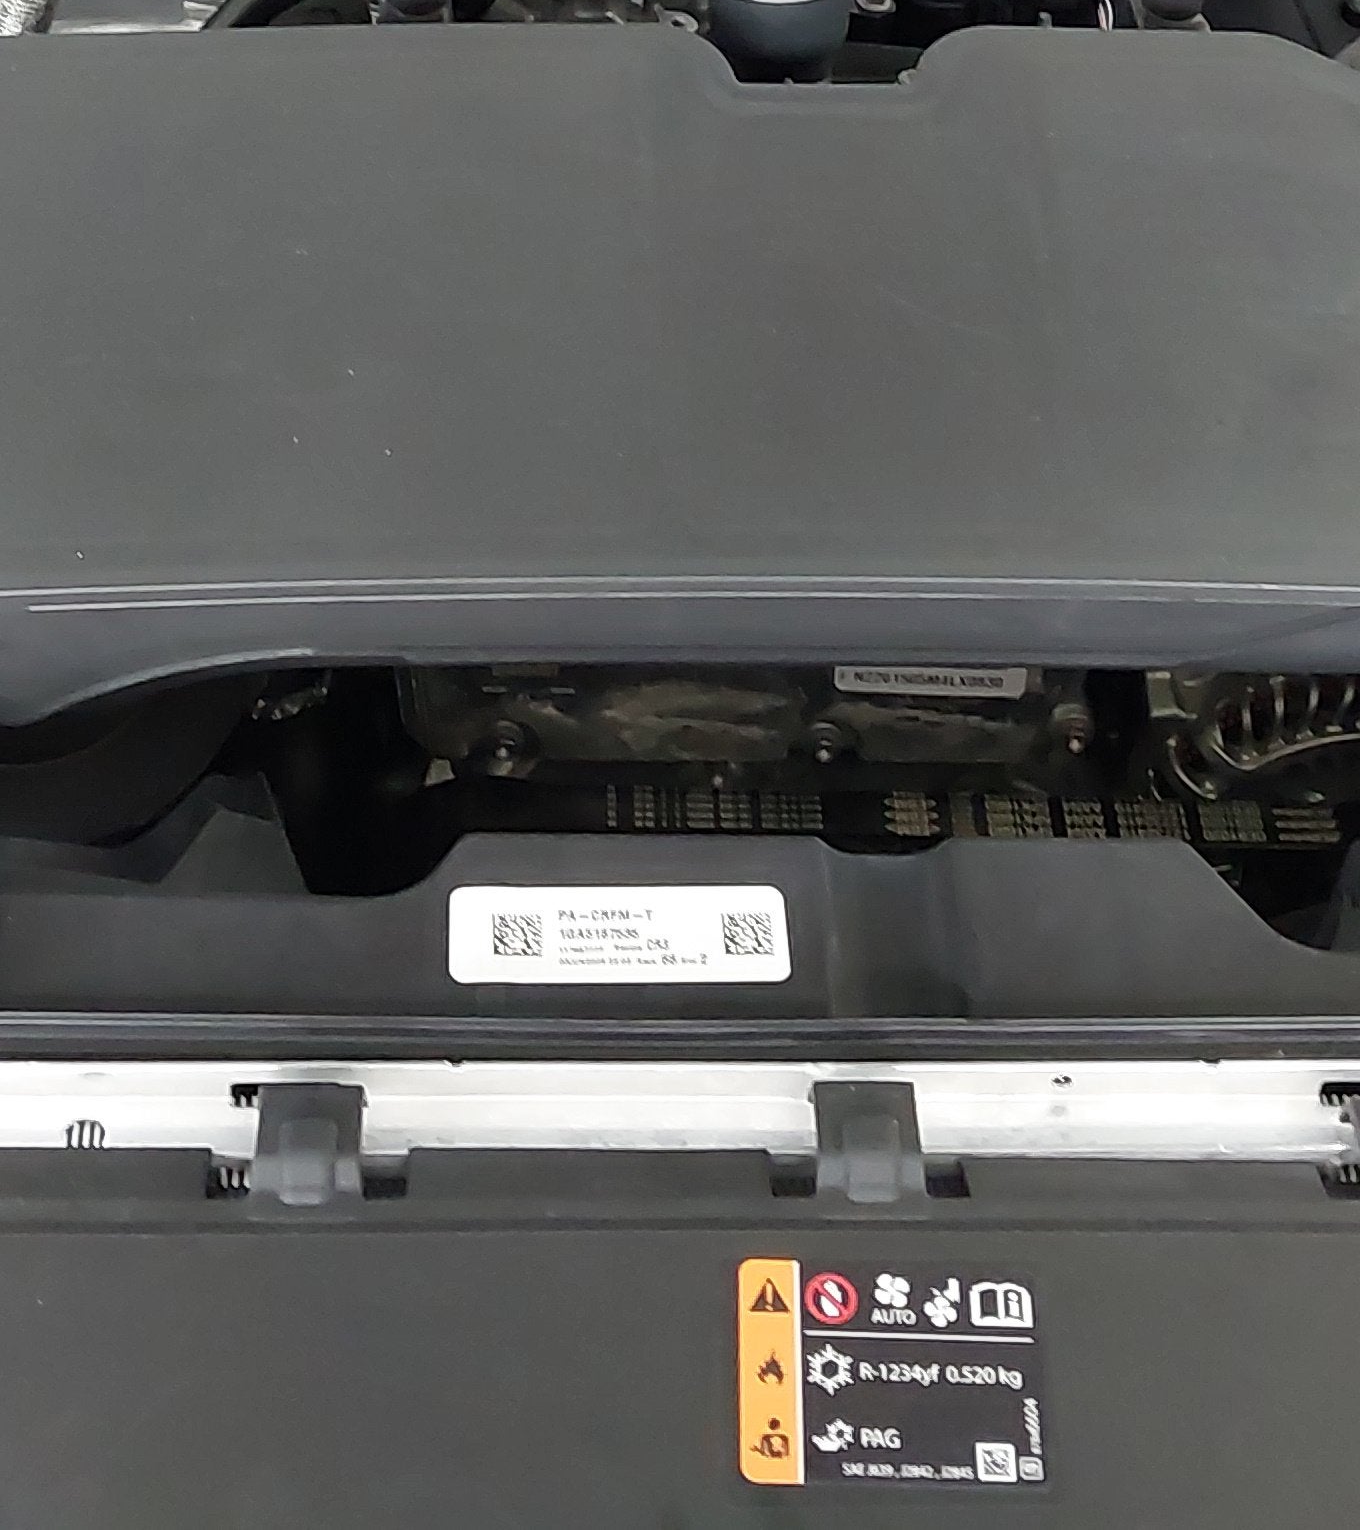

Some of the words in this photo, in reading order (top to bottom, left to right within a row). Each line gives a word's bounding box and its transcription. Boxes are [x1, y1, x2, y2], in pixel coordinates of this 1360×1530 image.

[870, 1306, 917, 1325] AUTO
[998, 1365, 1024, 1390] kg
[859, 1426, 902, 1450] PAG
